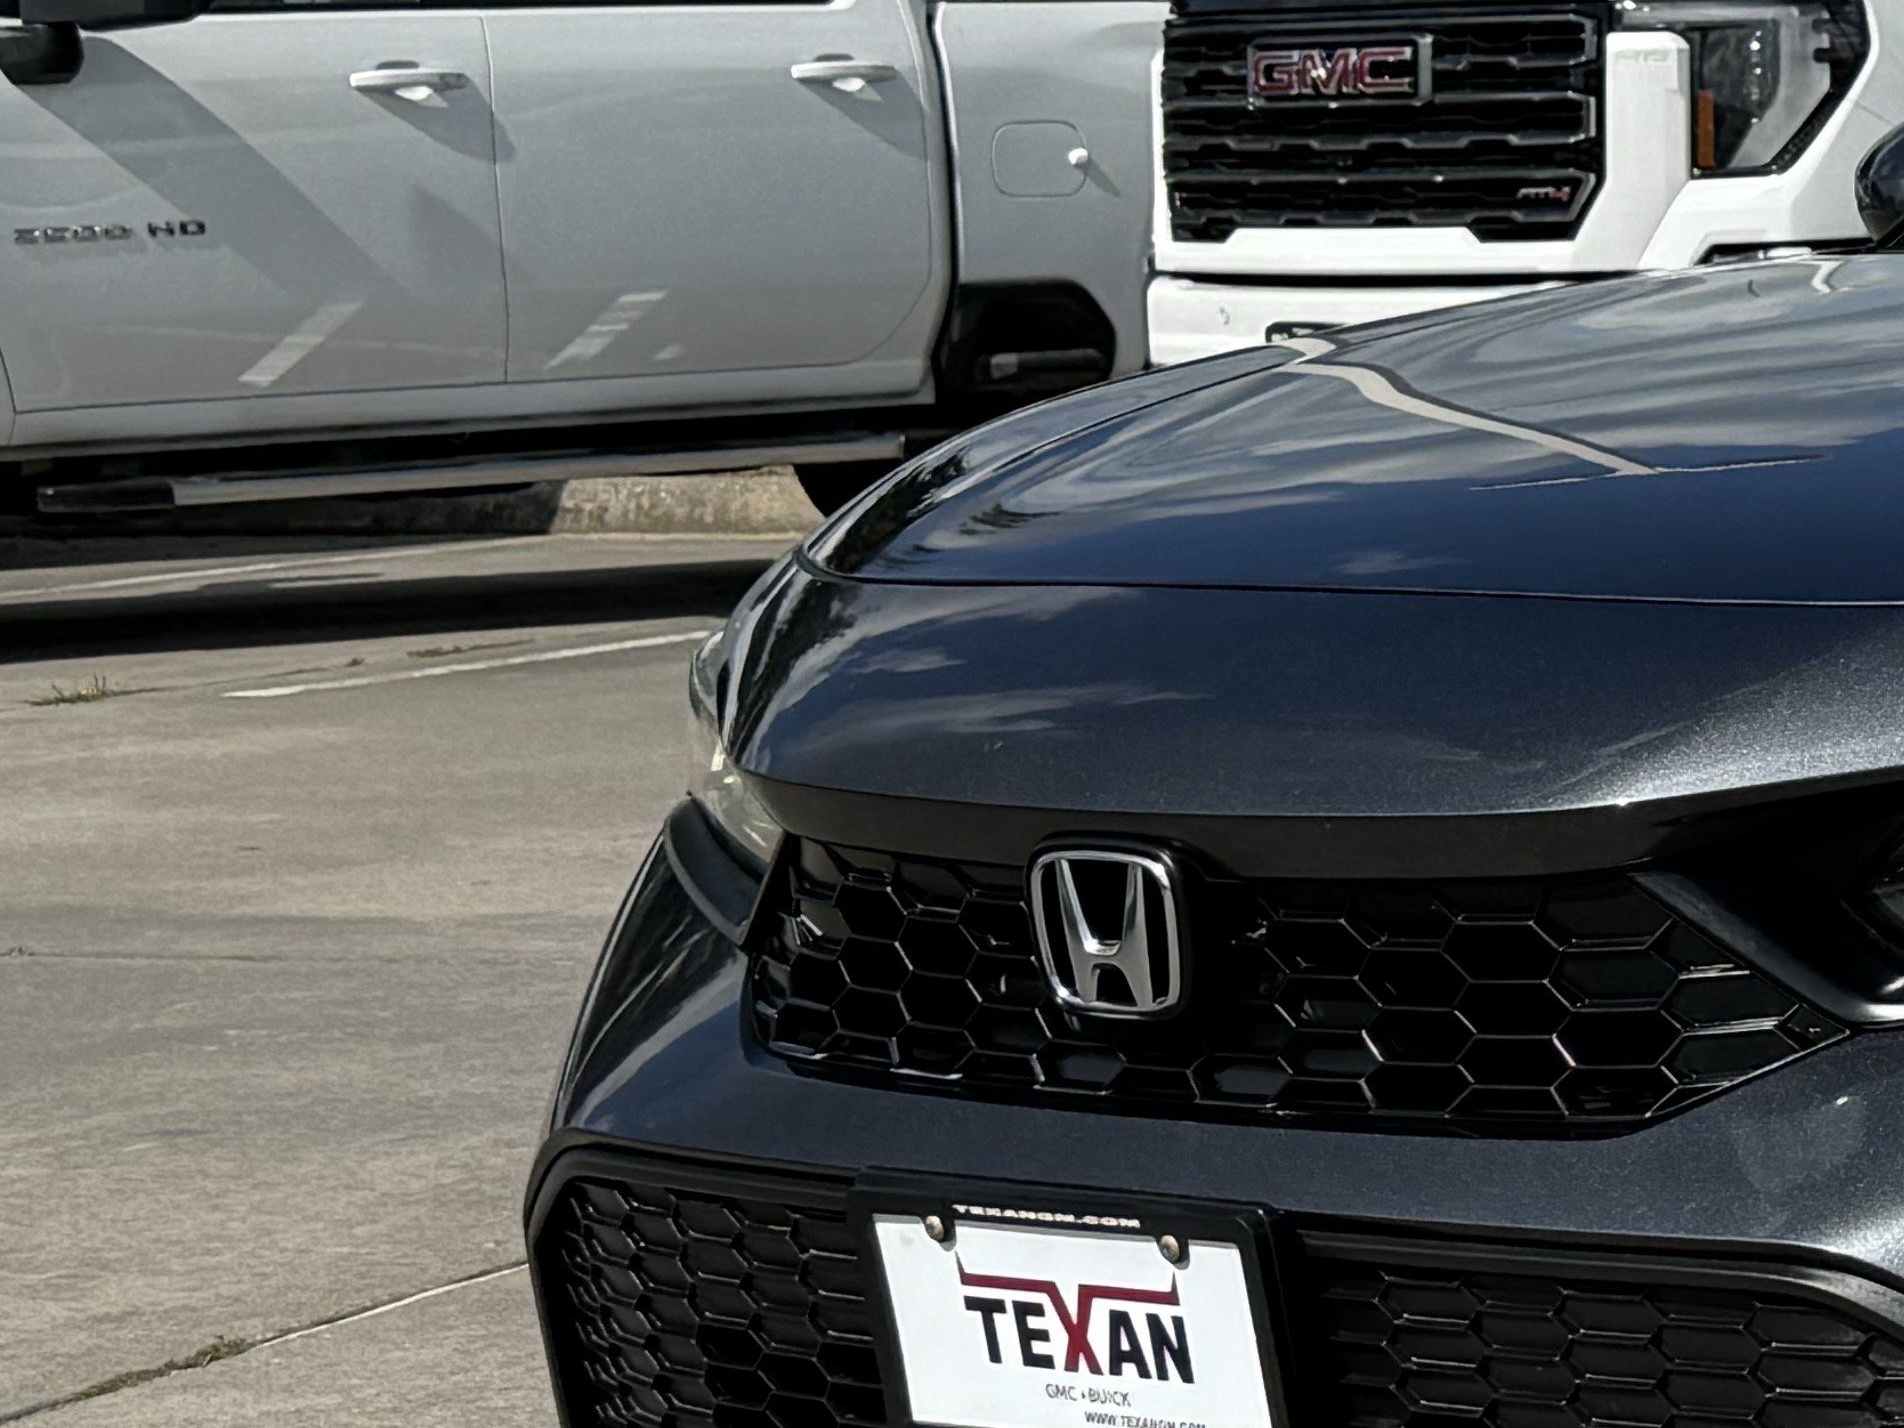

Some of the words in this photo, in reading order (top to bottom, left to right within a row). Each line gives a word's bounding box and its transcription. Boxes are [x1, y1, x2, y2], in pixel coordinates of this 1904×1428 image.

[1253, 47, 1414, 95] GMC
[960, 1275, 1196, 1385] TEXAN
[1046, 1383, 1077, 1401] GMC
